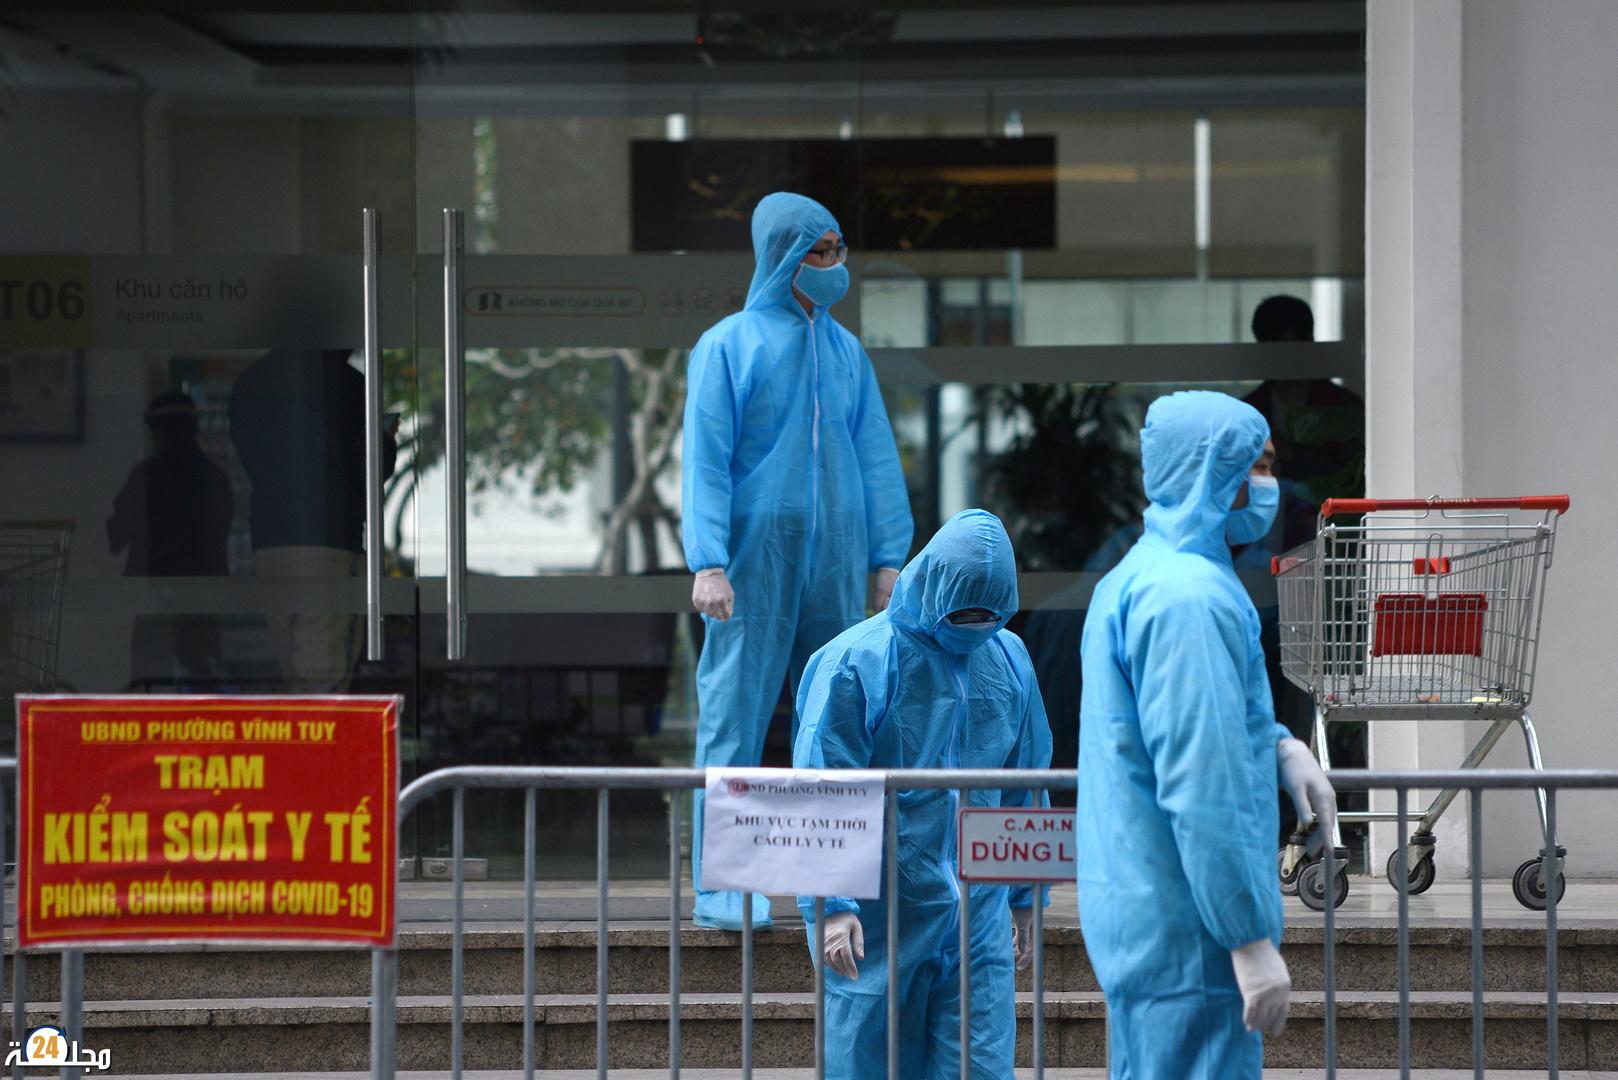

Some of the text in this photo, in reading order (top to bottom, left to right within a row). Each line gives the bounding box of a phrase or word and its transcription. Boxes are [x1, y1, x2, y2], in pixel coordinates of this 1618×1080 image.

[0, 279, 85, 321] T06
[115, 278, 249, 303] Khu căn hộ
[115, 308, 204, 323] Apartments
[81, 716, 337, 742] UBND PHƯỜNG VĨNH TUY
[154, 754, 265, 796] TRẠM
[43, 794, 372, 865] KIỂM SOÁT Y TẾ
[734, 814, 764, 827] KHU
[800, 816, 830, 831] TẠM
[971, 834, 1051, 862] DỪNG
[128, 870, 205, 915] CHỐNG
[211, 880, 265, 920] DỊCH
[272, 880, 374, 918] COVID-19
